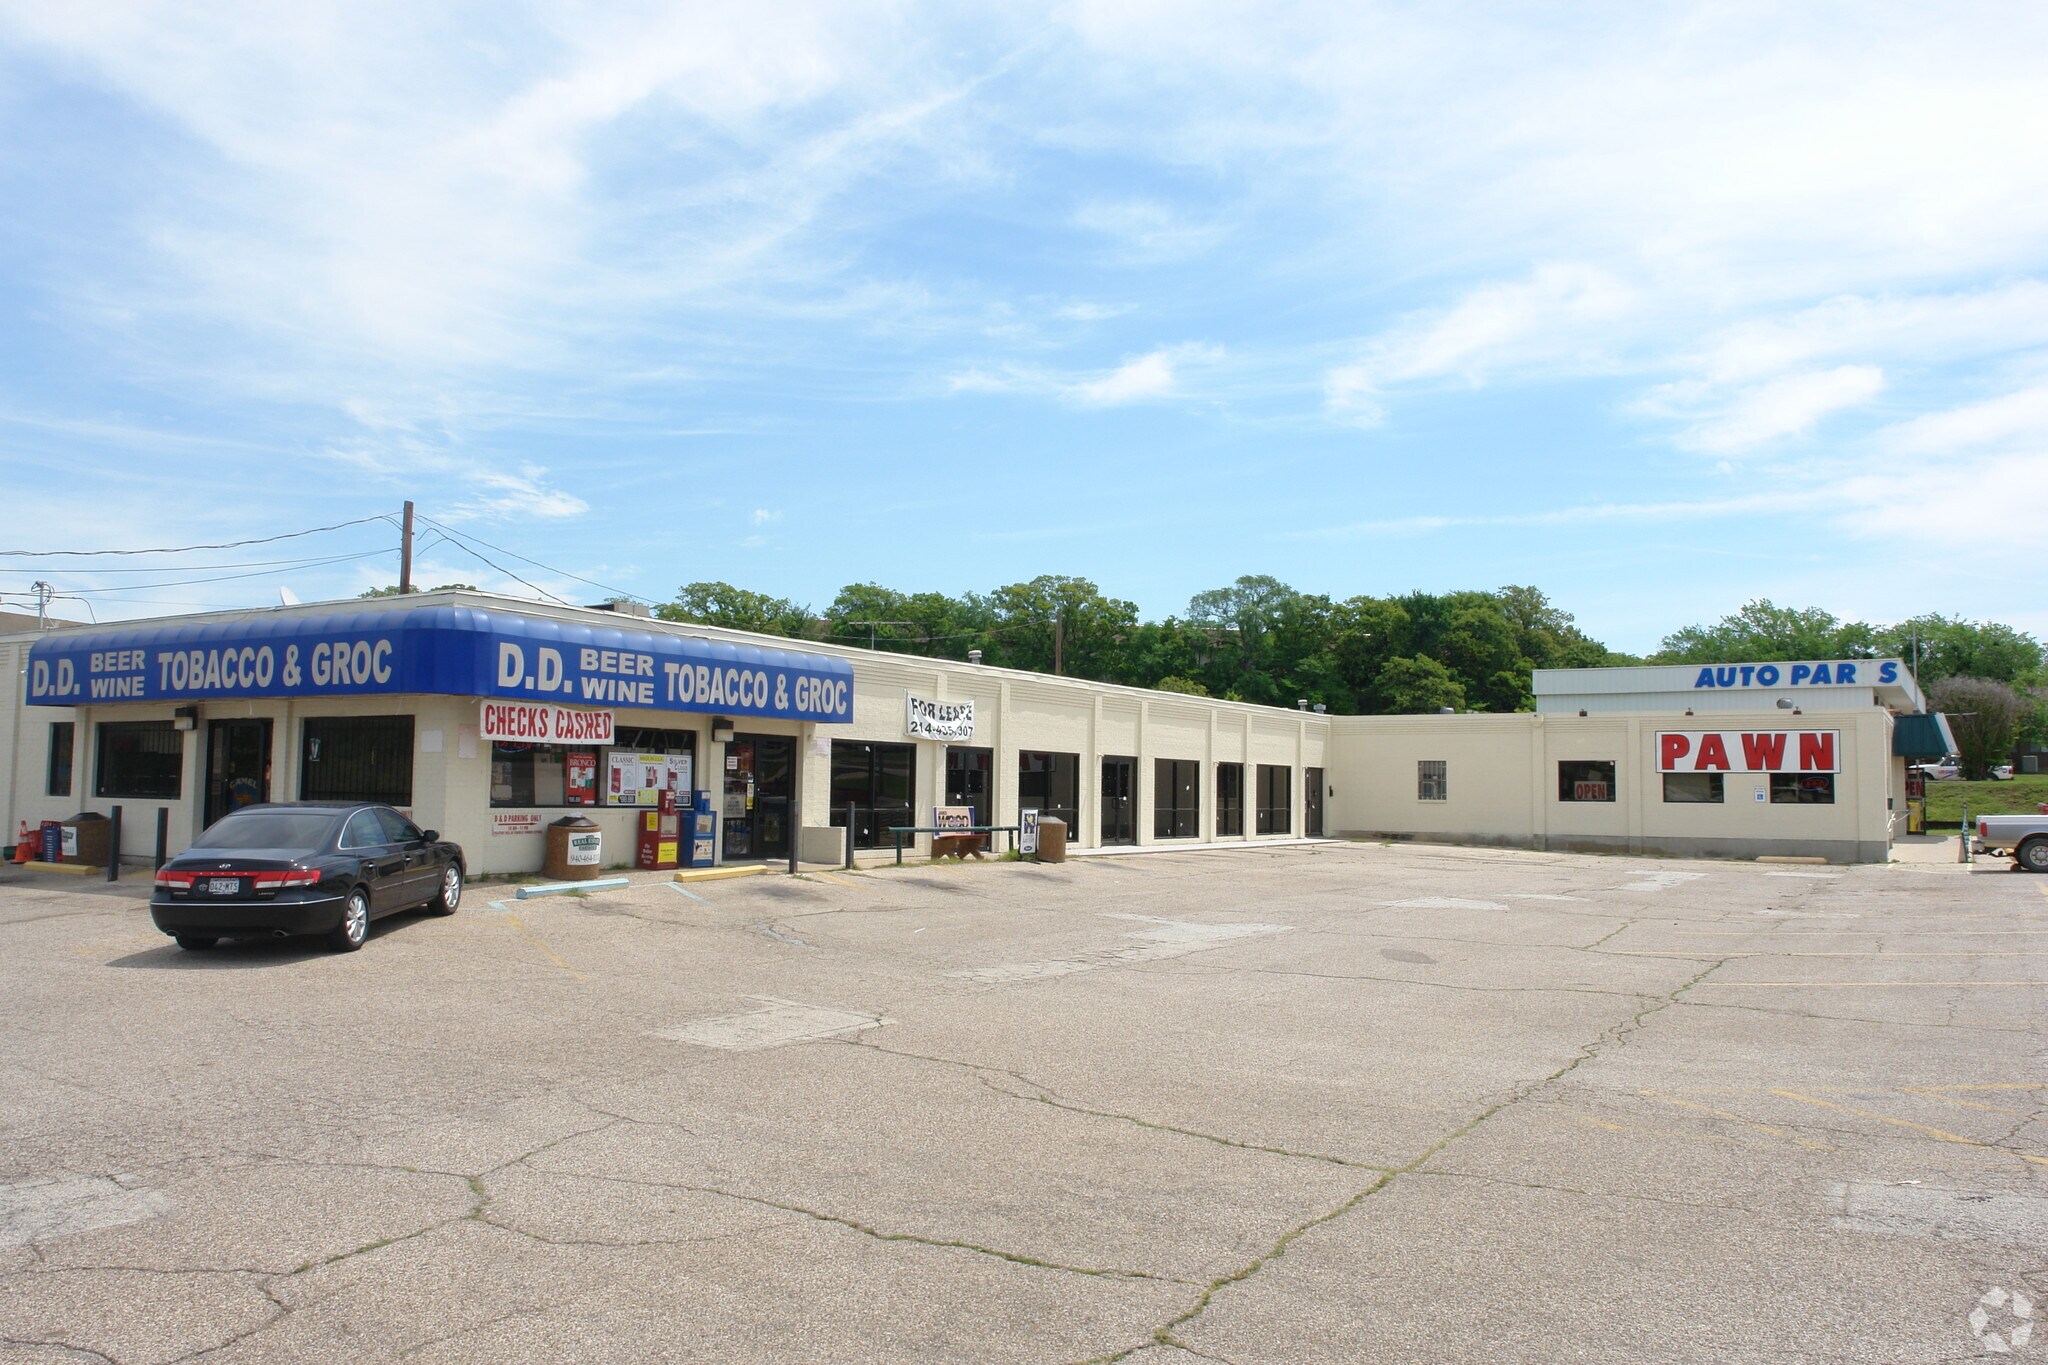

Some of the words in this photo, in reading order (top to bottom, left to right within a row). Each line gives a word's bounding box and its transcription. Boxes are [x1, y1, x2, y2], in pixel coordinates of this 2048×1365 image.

[90, 650, 146, 673] BEER
[158, 646, 275, 691] TOBACCO
[282, 644, 302, 687] &
[311, 639, 393, 687] GROC
[497, 642, 573, 694] D.D.
[580, 648, 655, 677] BEER
[32, 658, 81, 698] D.D.
[90, 675, 145, 699] WINE
[1694, 665, 1780, 688] AUTO
[580, 676, 655, 705] WINE
[664, 662, 769, 709] TOBACCO
[774, 673, 789, 710] &
[795, 675, 848, 716] GROC
[910, 697, 936, 720] FOR
[485, 704, 549, 738] CHECKS
[554, 709, 612, 739] CASHED
[569, 759, 596, 767] BRONCO
[611, 756, 635, 764] CLASSIC
[1661, 733, 1834, 770] PAWN
[229, 777, 258, 789] CAMEL
[1576, 784, 1606, 799] OPEN
[508, 814, 529, 822] PARKING
[938, 815, 969, 828] WOOD
